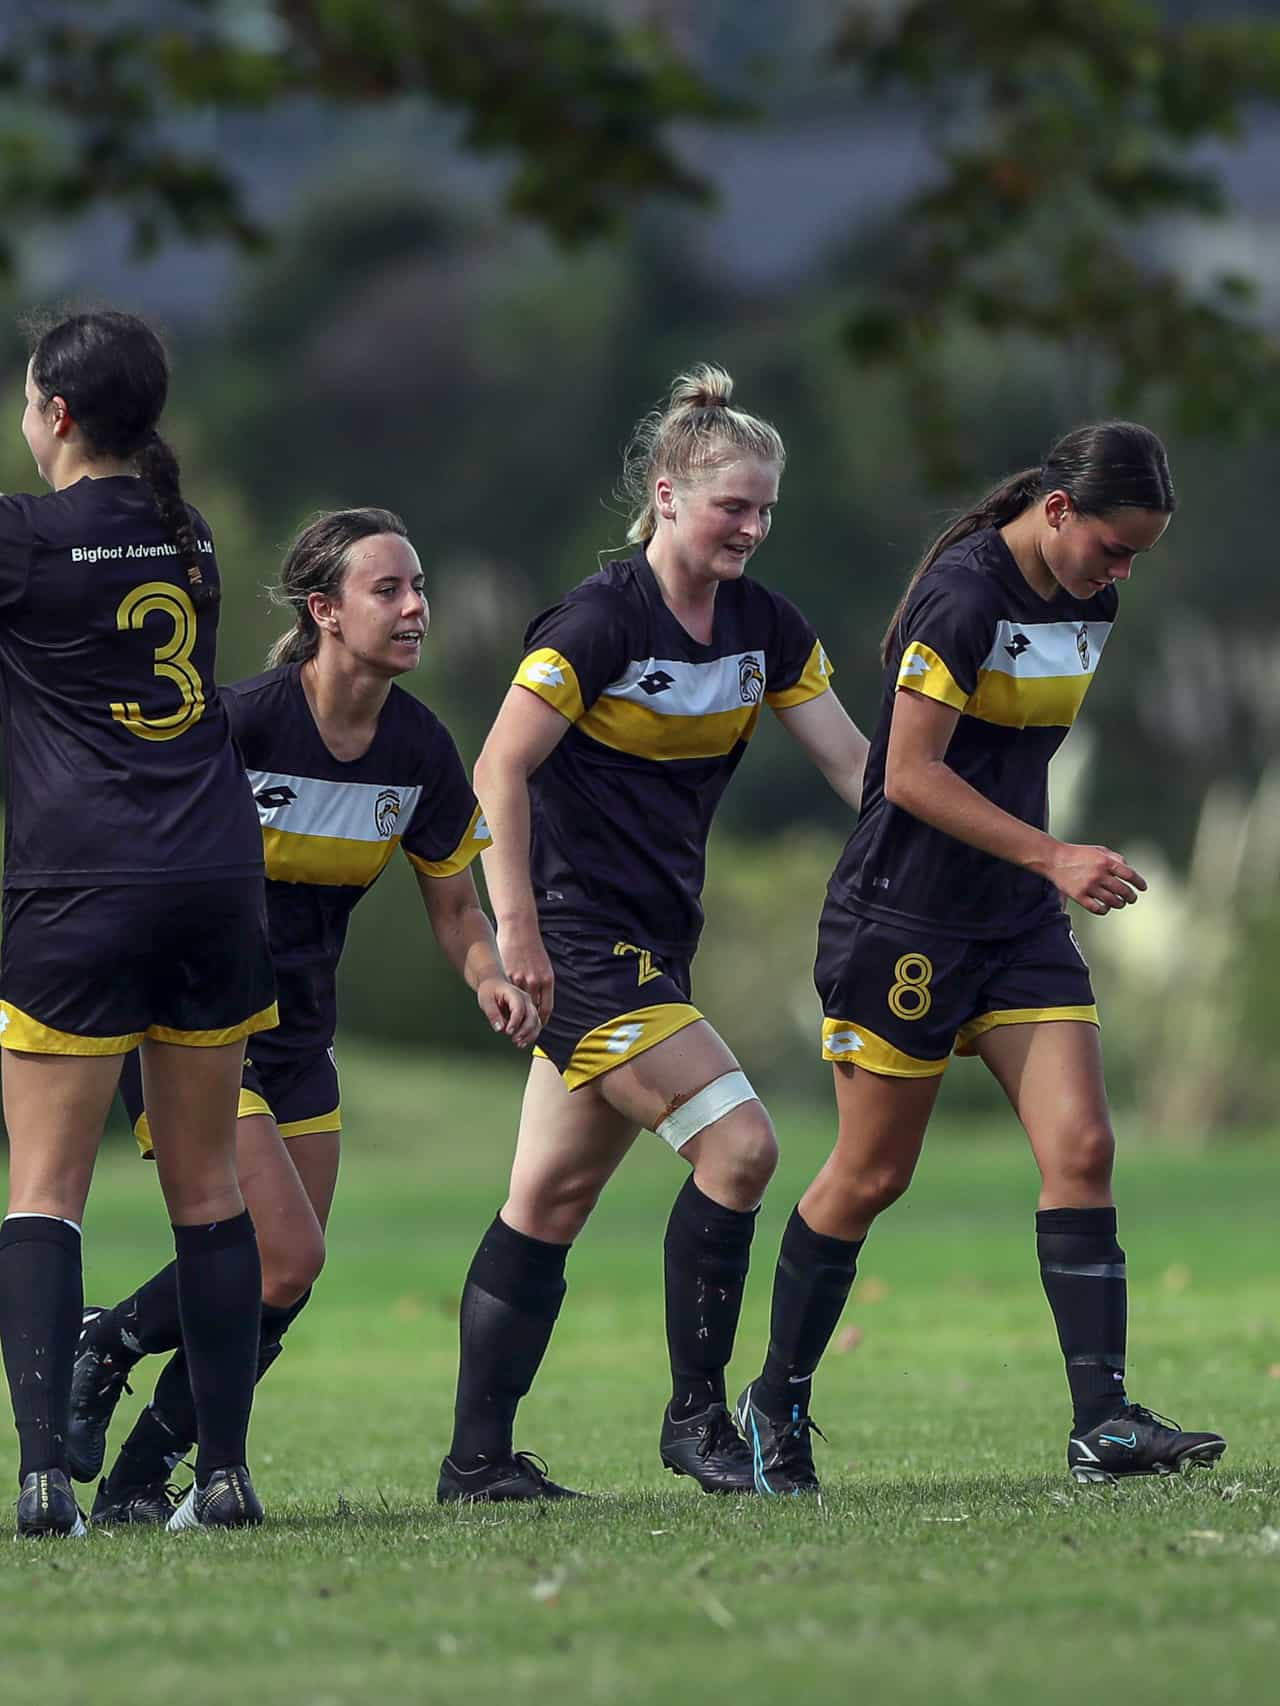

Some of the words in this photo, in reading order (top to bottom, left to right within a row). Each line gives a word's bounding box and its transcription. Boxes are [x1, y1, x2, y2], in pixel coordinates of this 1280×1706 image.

[71, 546, 122, 563] Bigfoot
[126, 543, 177, 558] Adventu
[109, 581, 206, 741] 3
[888, 953, 933, 1021] 8
